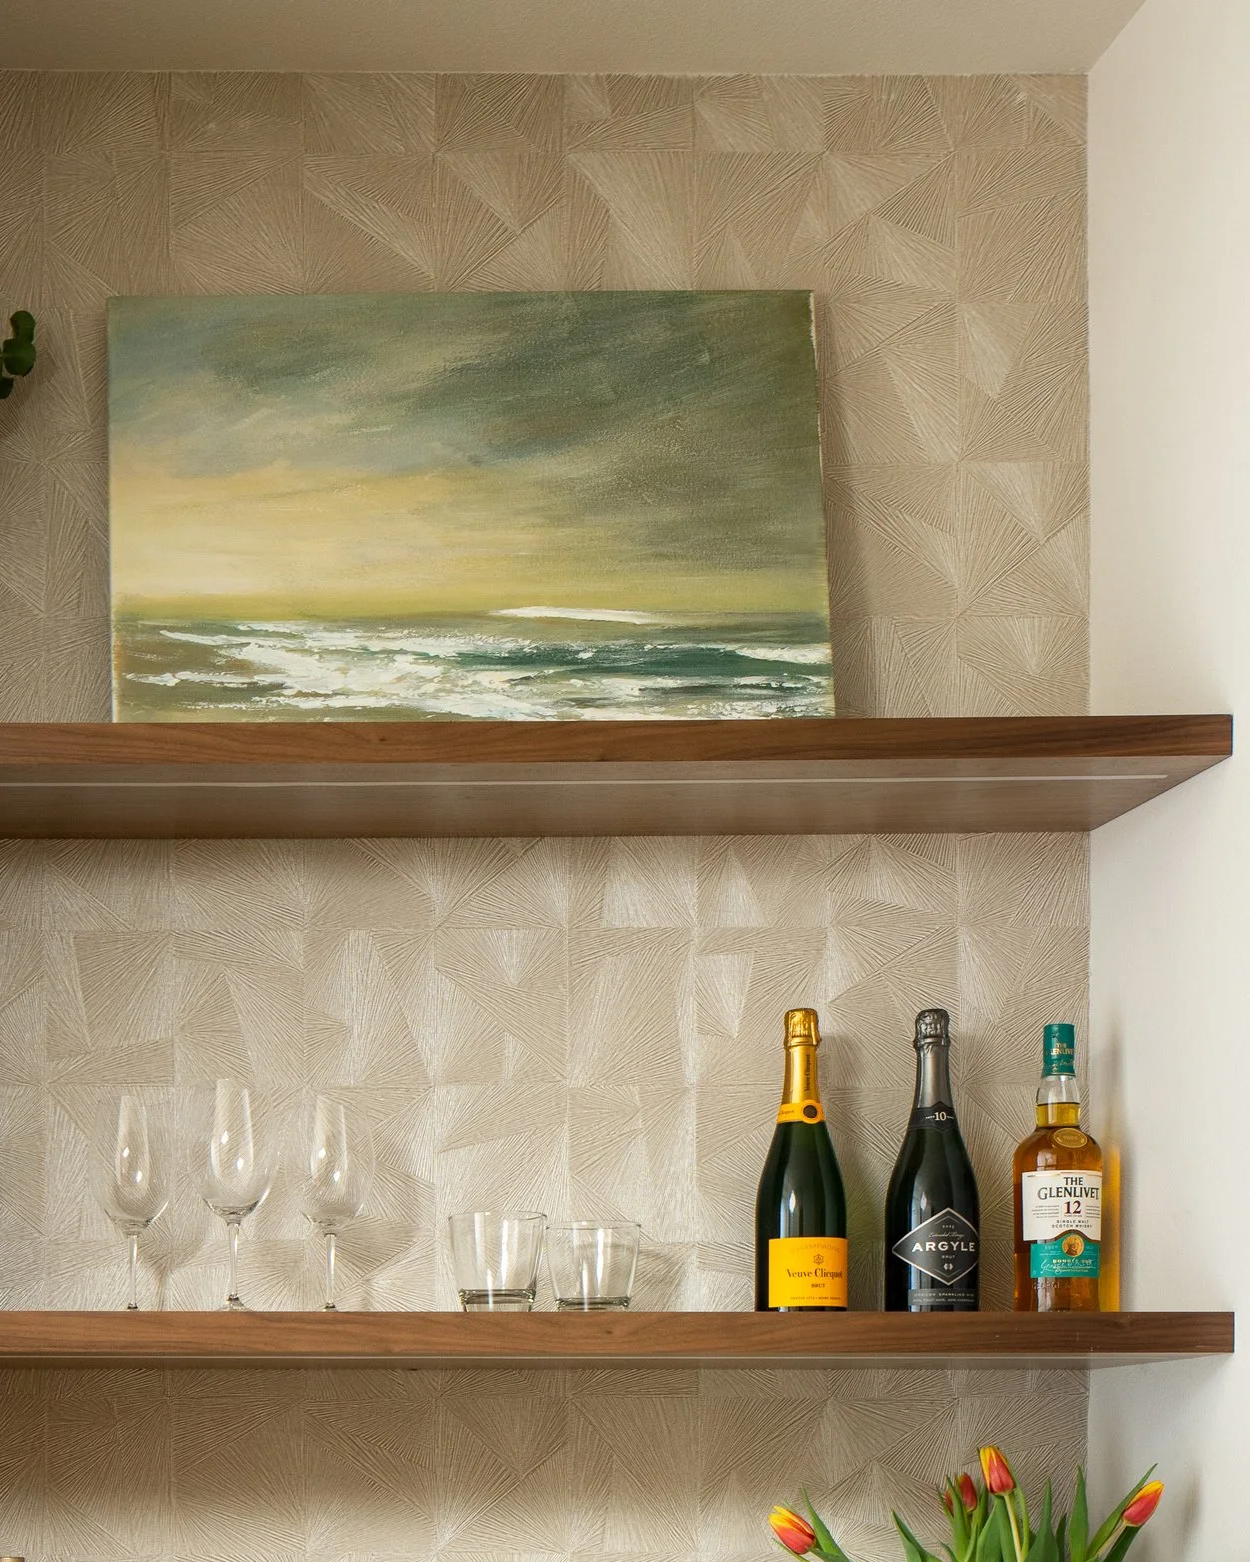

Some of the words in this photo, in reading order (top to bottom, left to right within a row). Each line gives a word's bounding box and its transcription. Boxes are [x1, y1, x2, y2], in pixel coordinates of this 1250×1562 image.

[934, 1111, 947, 1121] 10
[1063, 1176, 1084, 1186] THE
[1037, 1186, 1100, 1201] GLENLIVET
[1064, 1200, 1082, 1215] 12
[911, 1241, 975, 1253] ARGYLE
[786, 1268, 813, 1278] Veuve
[814, 1267, 843, 1280] Clicquot
